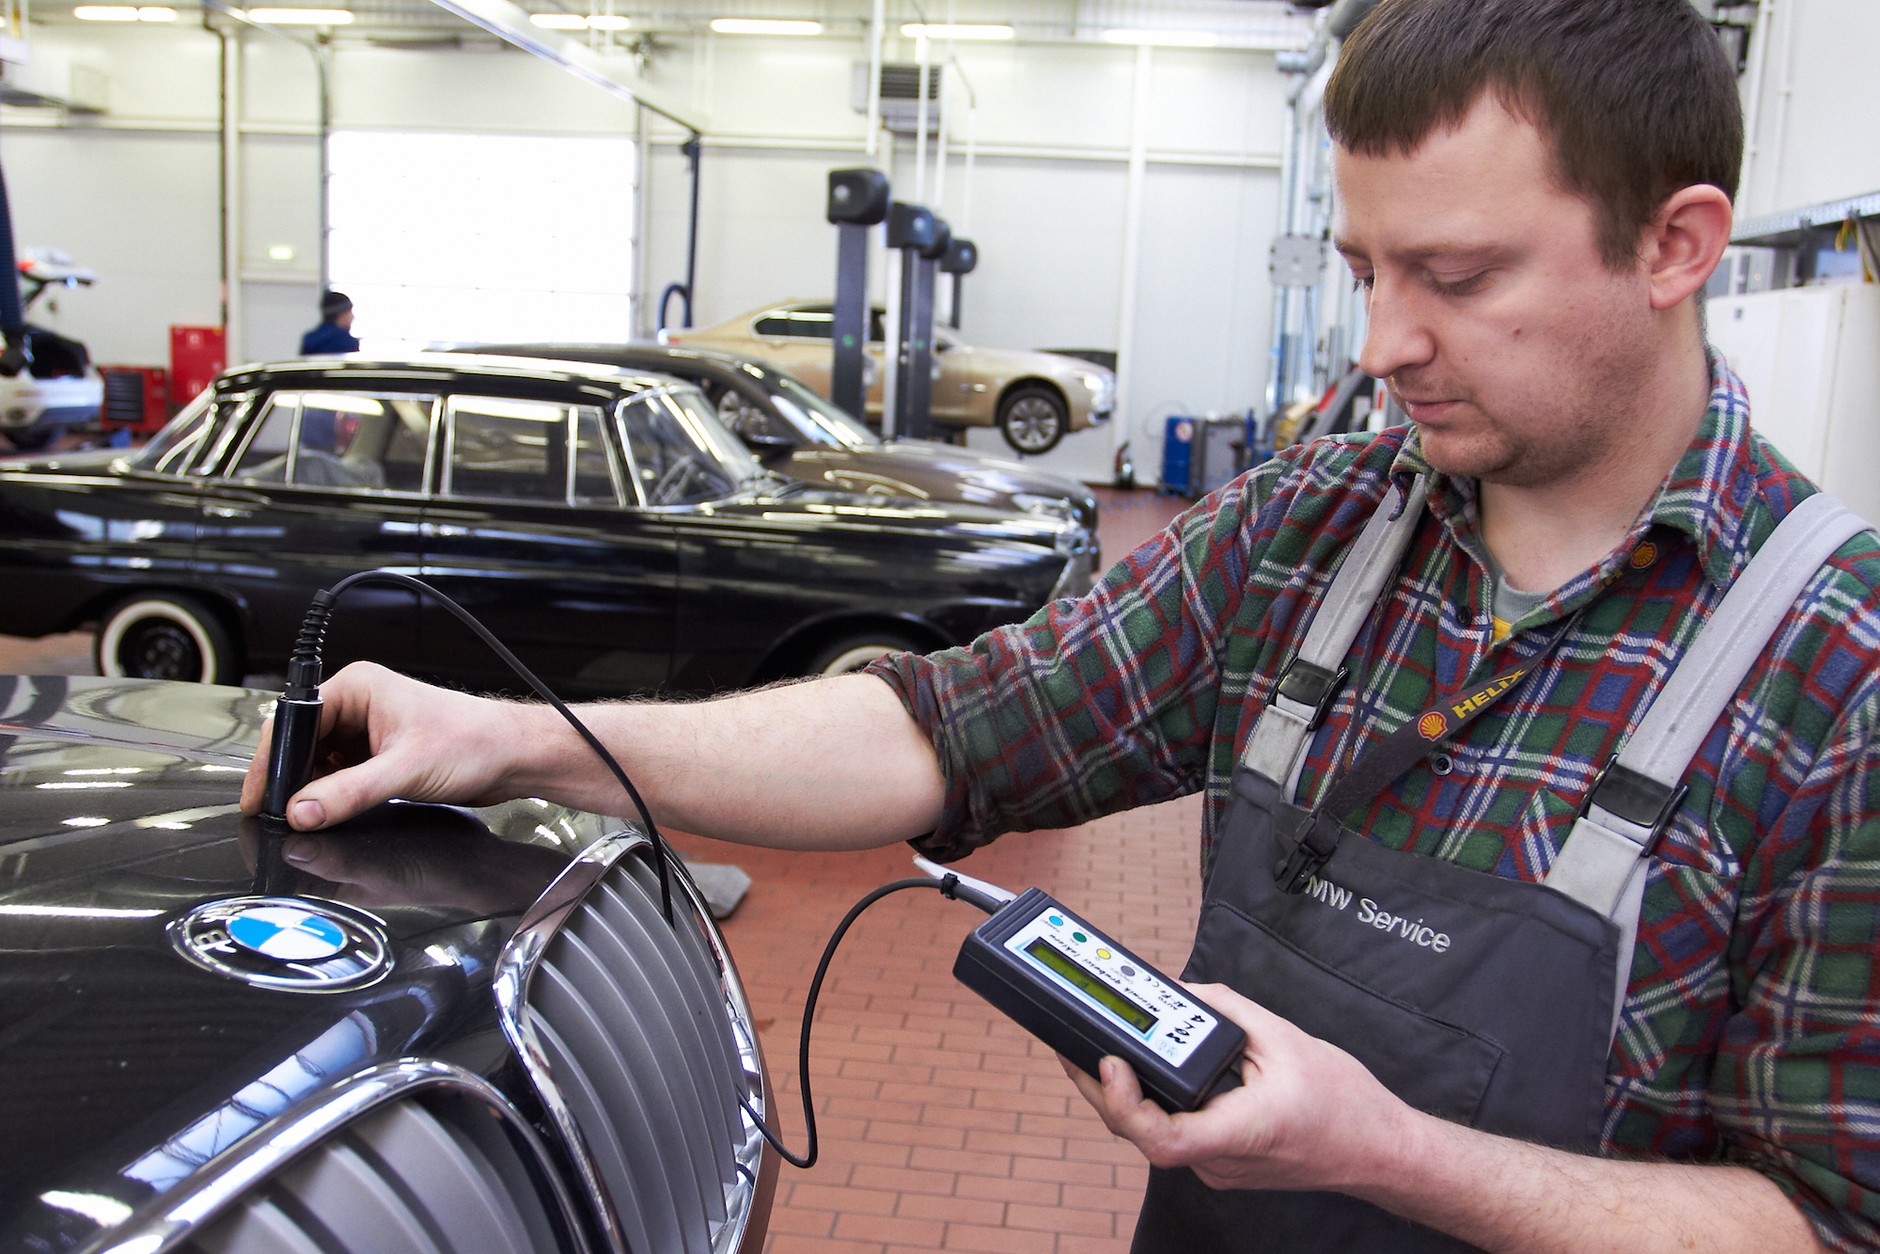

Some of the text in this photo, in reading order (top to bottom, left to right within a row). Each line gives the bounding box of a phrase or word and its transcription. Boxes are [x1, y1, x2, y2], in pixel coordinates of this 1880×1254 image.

[1452, 668, 1527, 719] HELIX
[1304, 875, 1451, 953] MW Service
